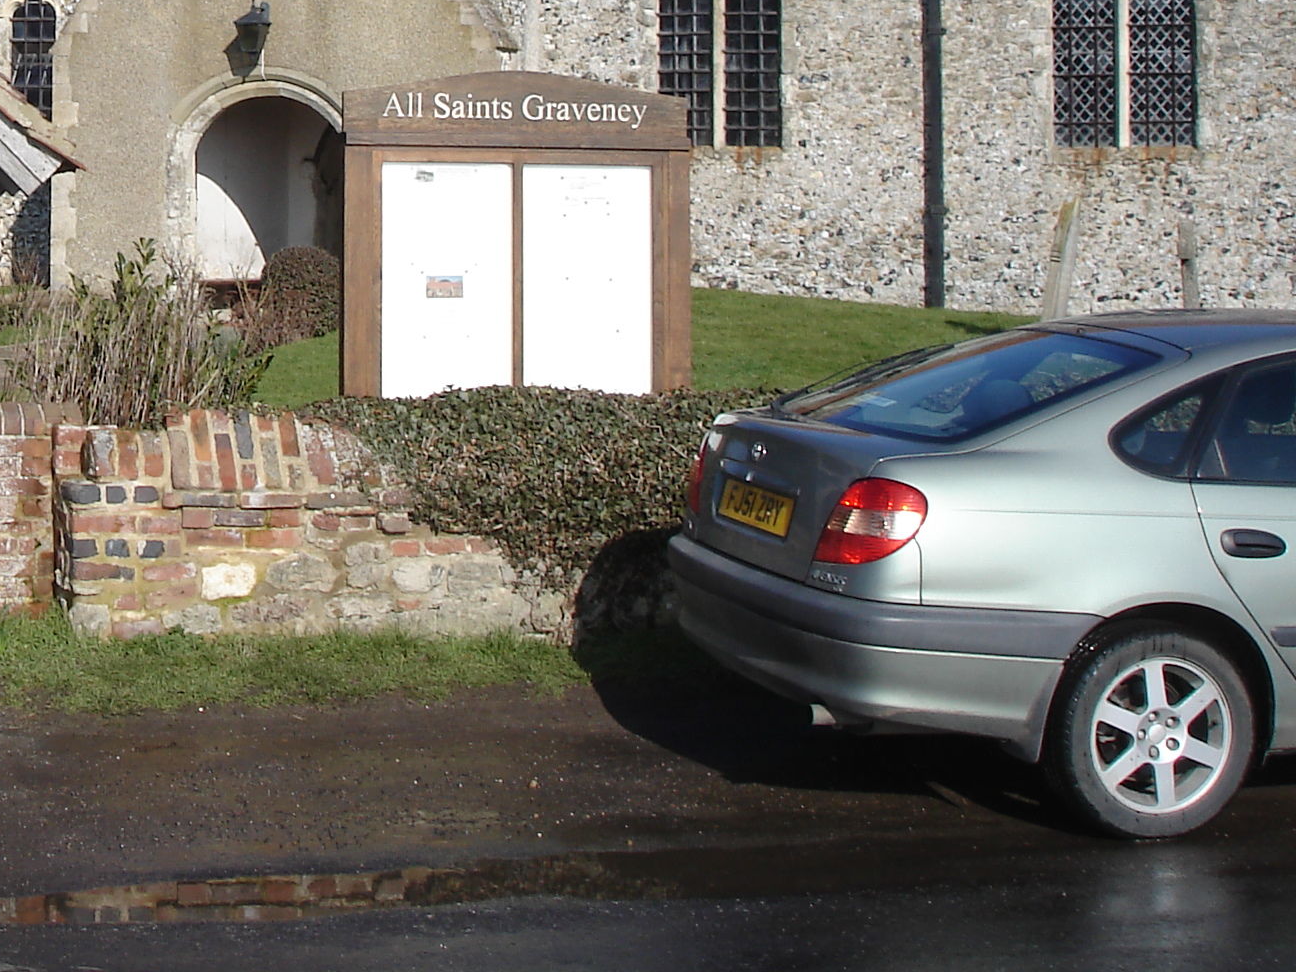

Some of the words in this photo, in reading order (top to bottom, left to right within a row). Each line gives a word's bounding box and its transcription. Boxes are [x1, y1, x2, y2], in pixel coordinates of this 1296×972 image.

[382, 92, 423, 118] All
[433, 92, 513, 120] Saints
[521, 94, 647, 129] Graveney
